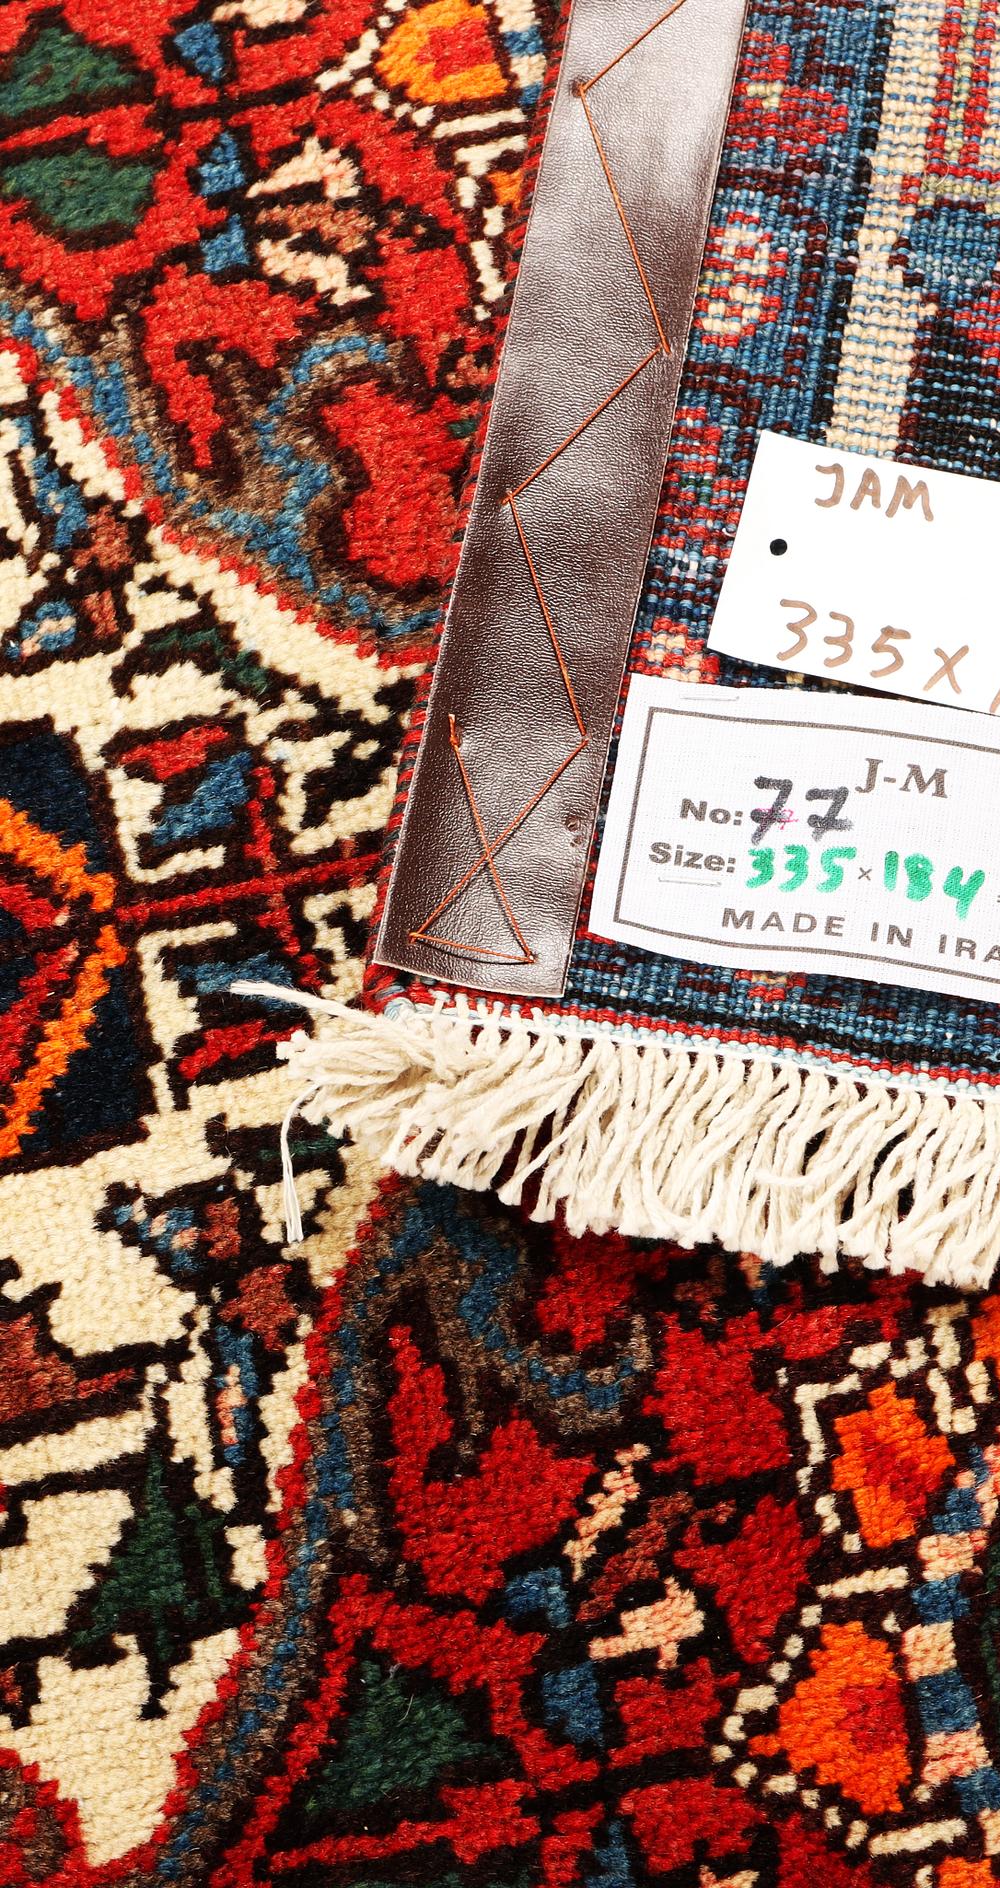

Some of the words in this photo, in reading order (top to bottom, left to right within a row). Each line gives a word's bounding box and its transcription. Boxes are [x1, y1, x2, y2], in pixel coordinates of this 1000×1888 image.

[814, 463, 935, 522] JAM
[776, 598, 911, 678] 335
[679, 798, 744, 827] No:
[750, 775, 854, 846] 77
[855, 757, 949, 799] J-M
[648, 841, 737, 875] Size:
[744, 844, 857, 894] 335
[883, 849, 986, 921] 184
[721, 907, 845, 938] MADE
[871, 922, 914, 948] IN
